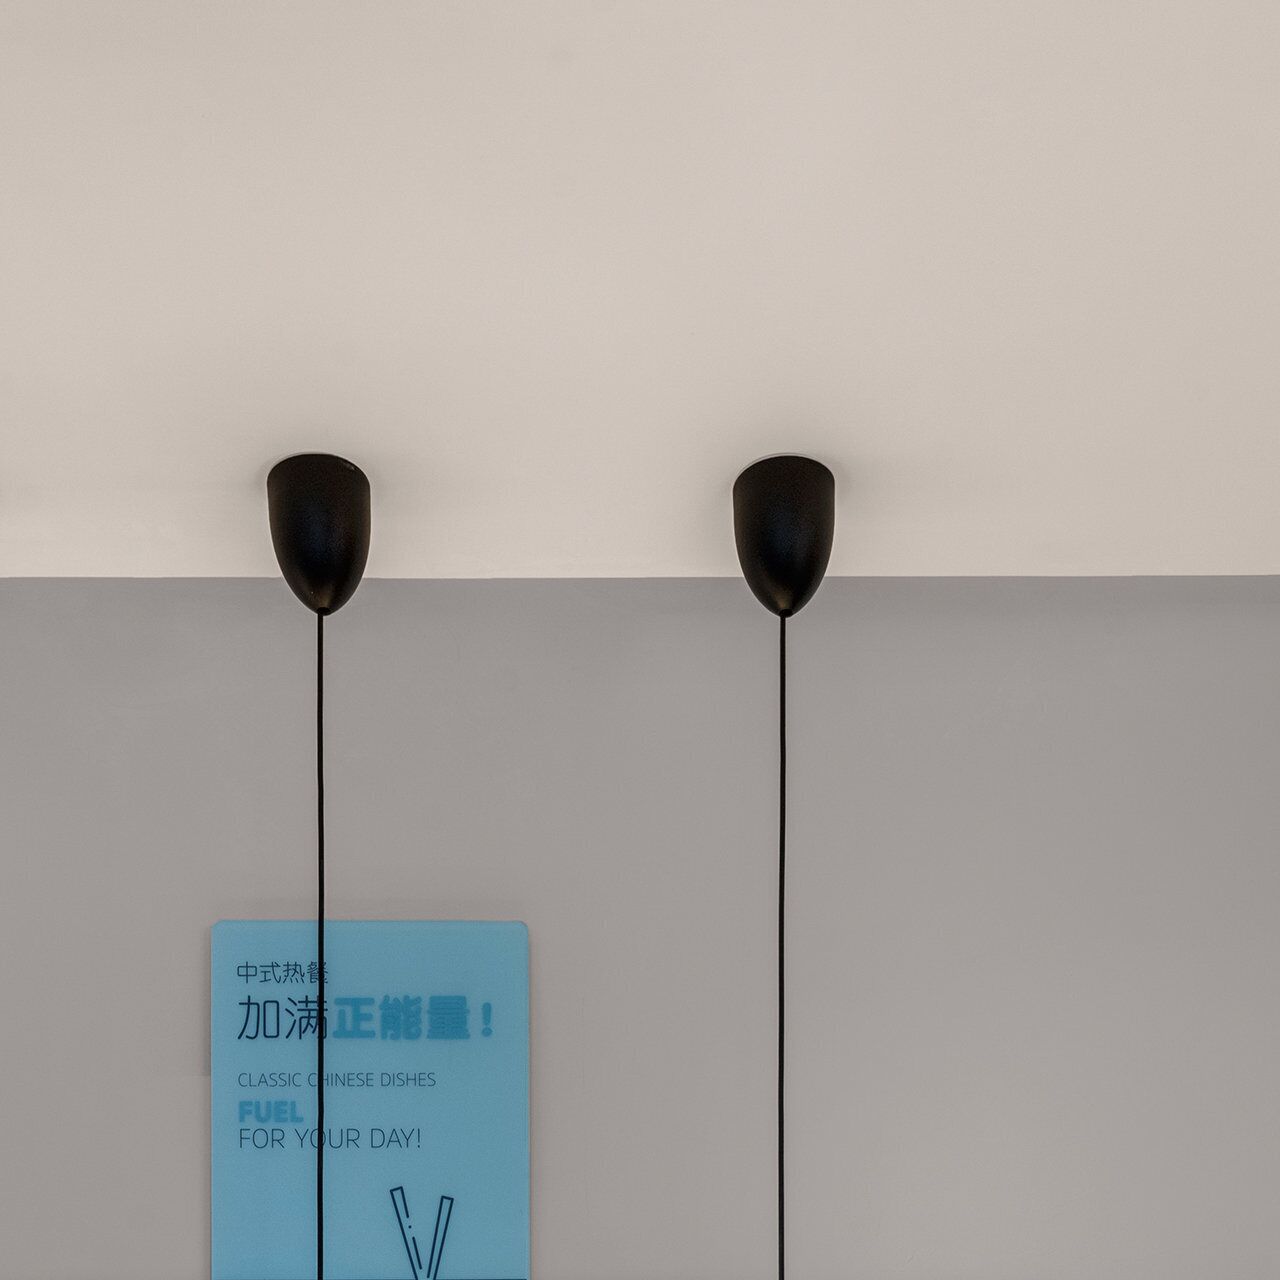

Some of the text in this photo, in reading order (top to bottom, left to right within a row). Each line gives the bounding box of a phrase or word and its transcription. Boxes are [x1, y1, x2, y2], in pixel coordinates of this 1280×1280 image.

[236, 961, 329, 985] 中式热餐
[237, 1072, 437, 1087] CLASSIC CHINESE DISHES
[238, 1099, 304, 1124] FUEL
[239, 1127, 421, 1149] FOR YOUR DAY!
